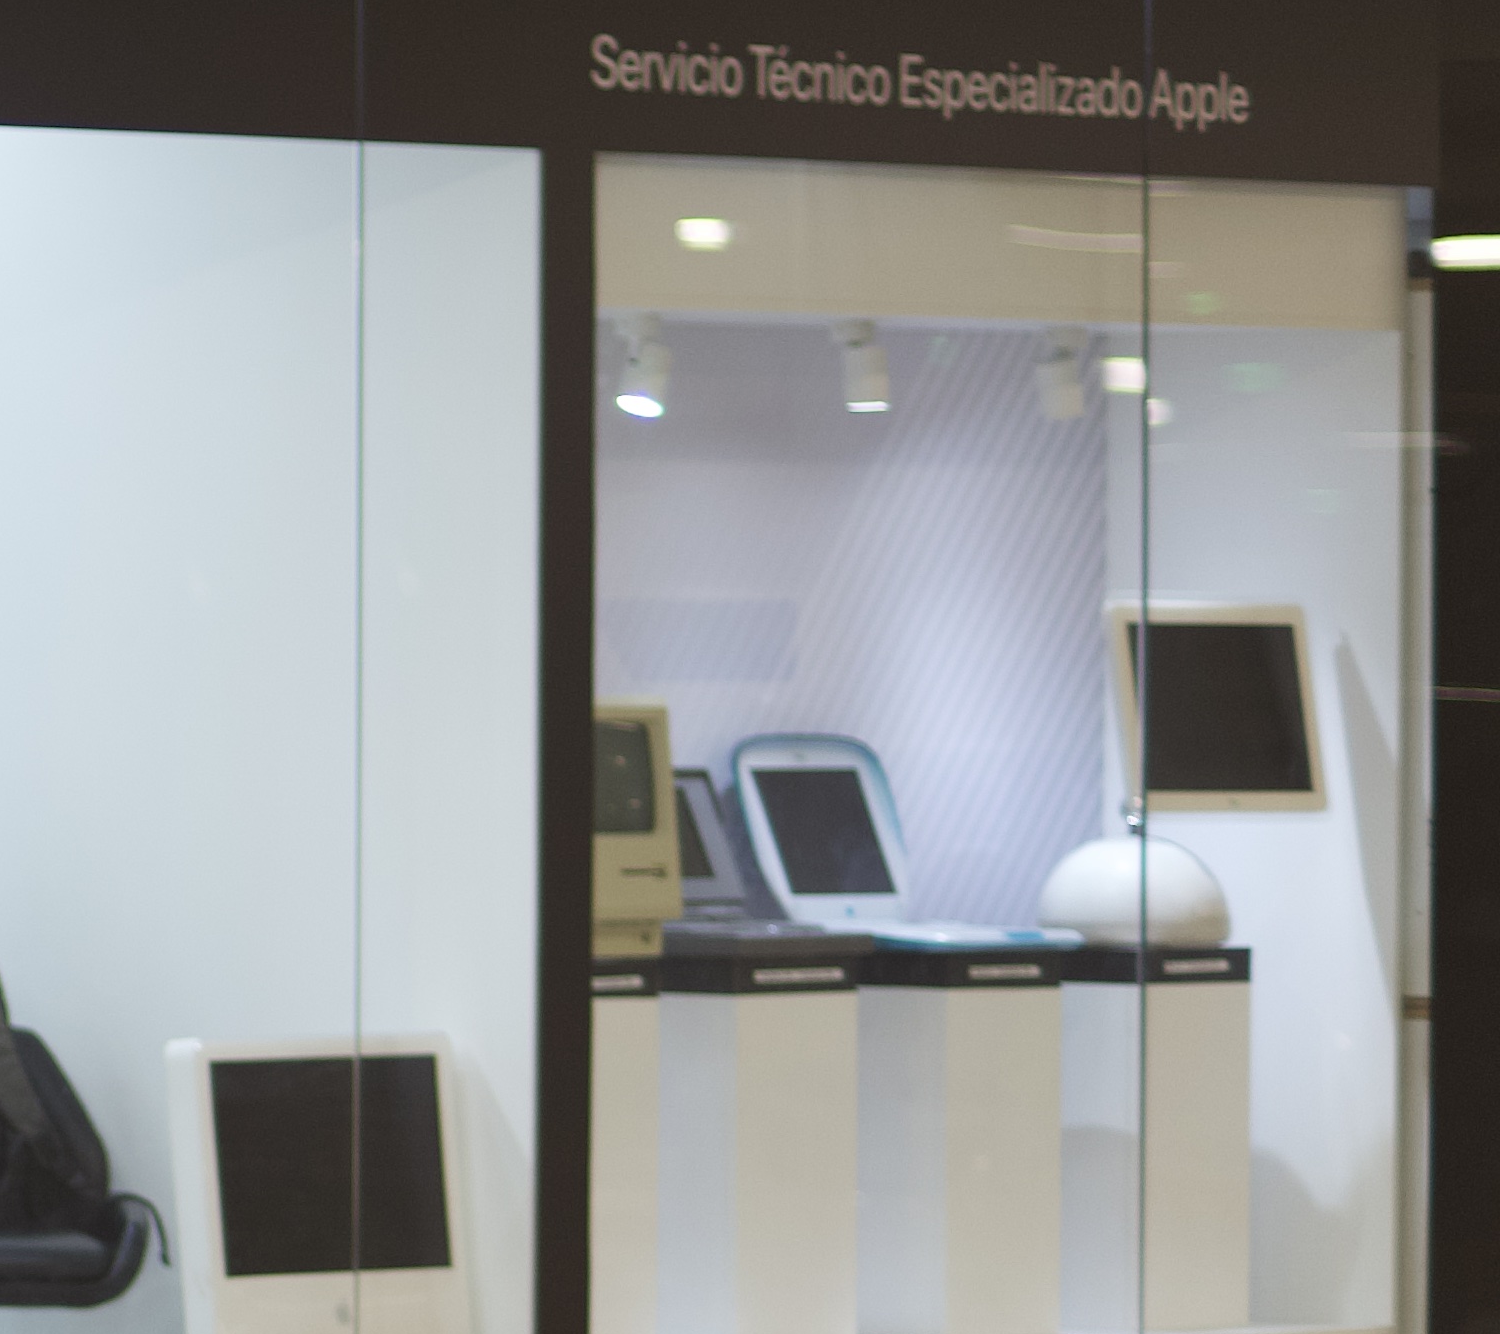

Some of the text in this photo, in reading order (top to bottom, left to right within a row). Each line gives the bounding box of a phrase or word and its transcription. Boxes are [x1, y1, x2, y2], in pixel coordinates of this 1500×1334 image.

[590, 34, 1250, 131] Servicio Técnico Especializado Apple
